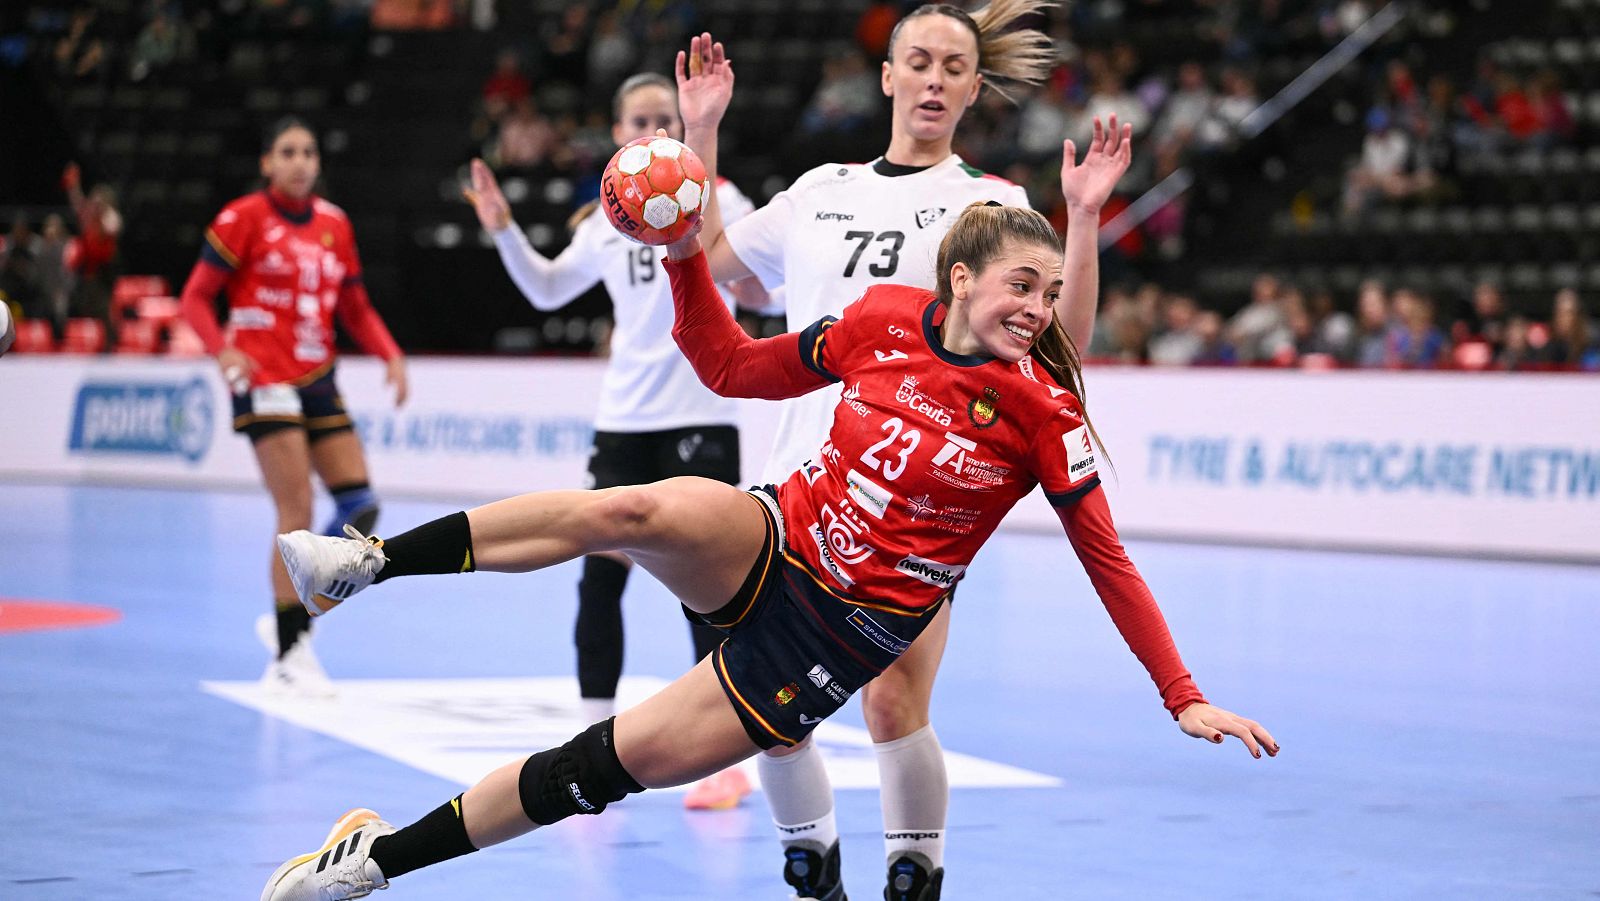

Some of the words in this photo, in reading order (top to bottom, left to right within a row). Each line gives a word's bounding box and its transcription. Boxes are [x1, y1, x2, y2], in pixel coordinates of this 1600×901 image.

[603, 174, 639, 232] SELECT
[815, 210, 855, 222] Kempa
[628, 245, 655, 286] 19
[842, 230, 906, 277] 73
[908, 394, 952, 427] Ceuta
[860, 417, 921, 481] 23
[1147, 434, 1228, 486] TYRE
[1240, 436, 1265, 488] &
[1277, 439, 1478, 495] AUTOCARE
[932, 469, 970, 489] PATRIMONIO
